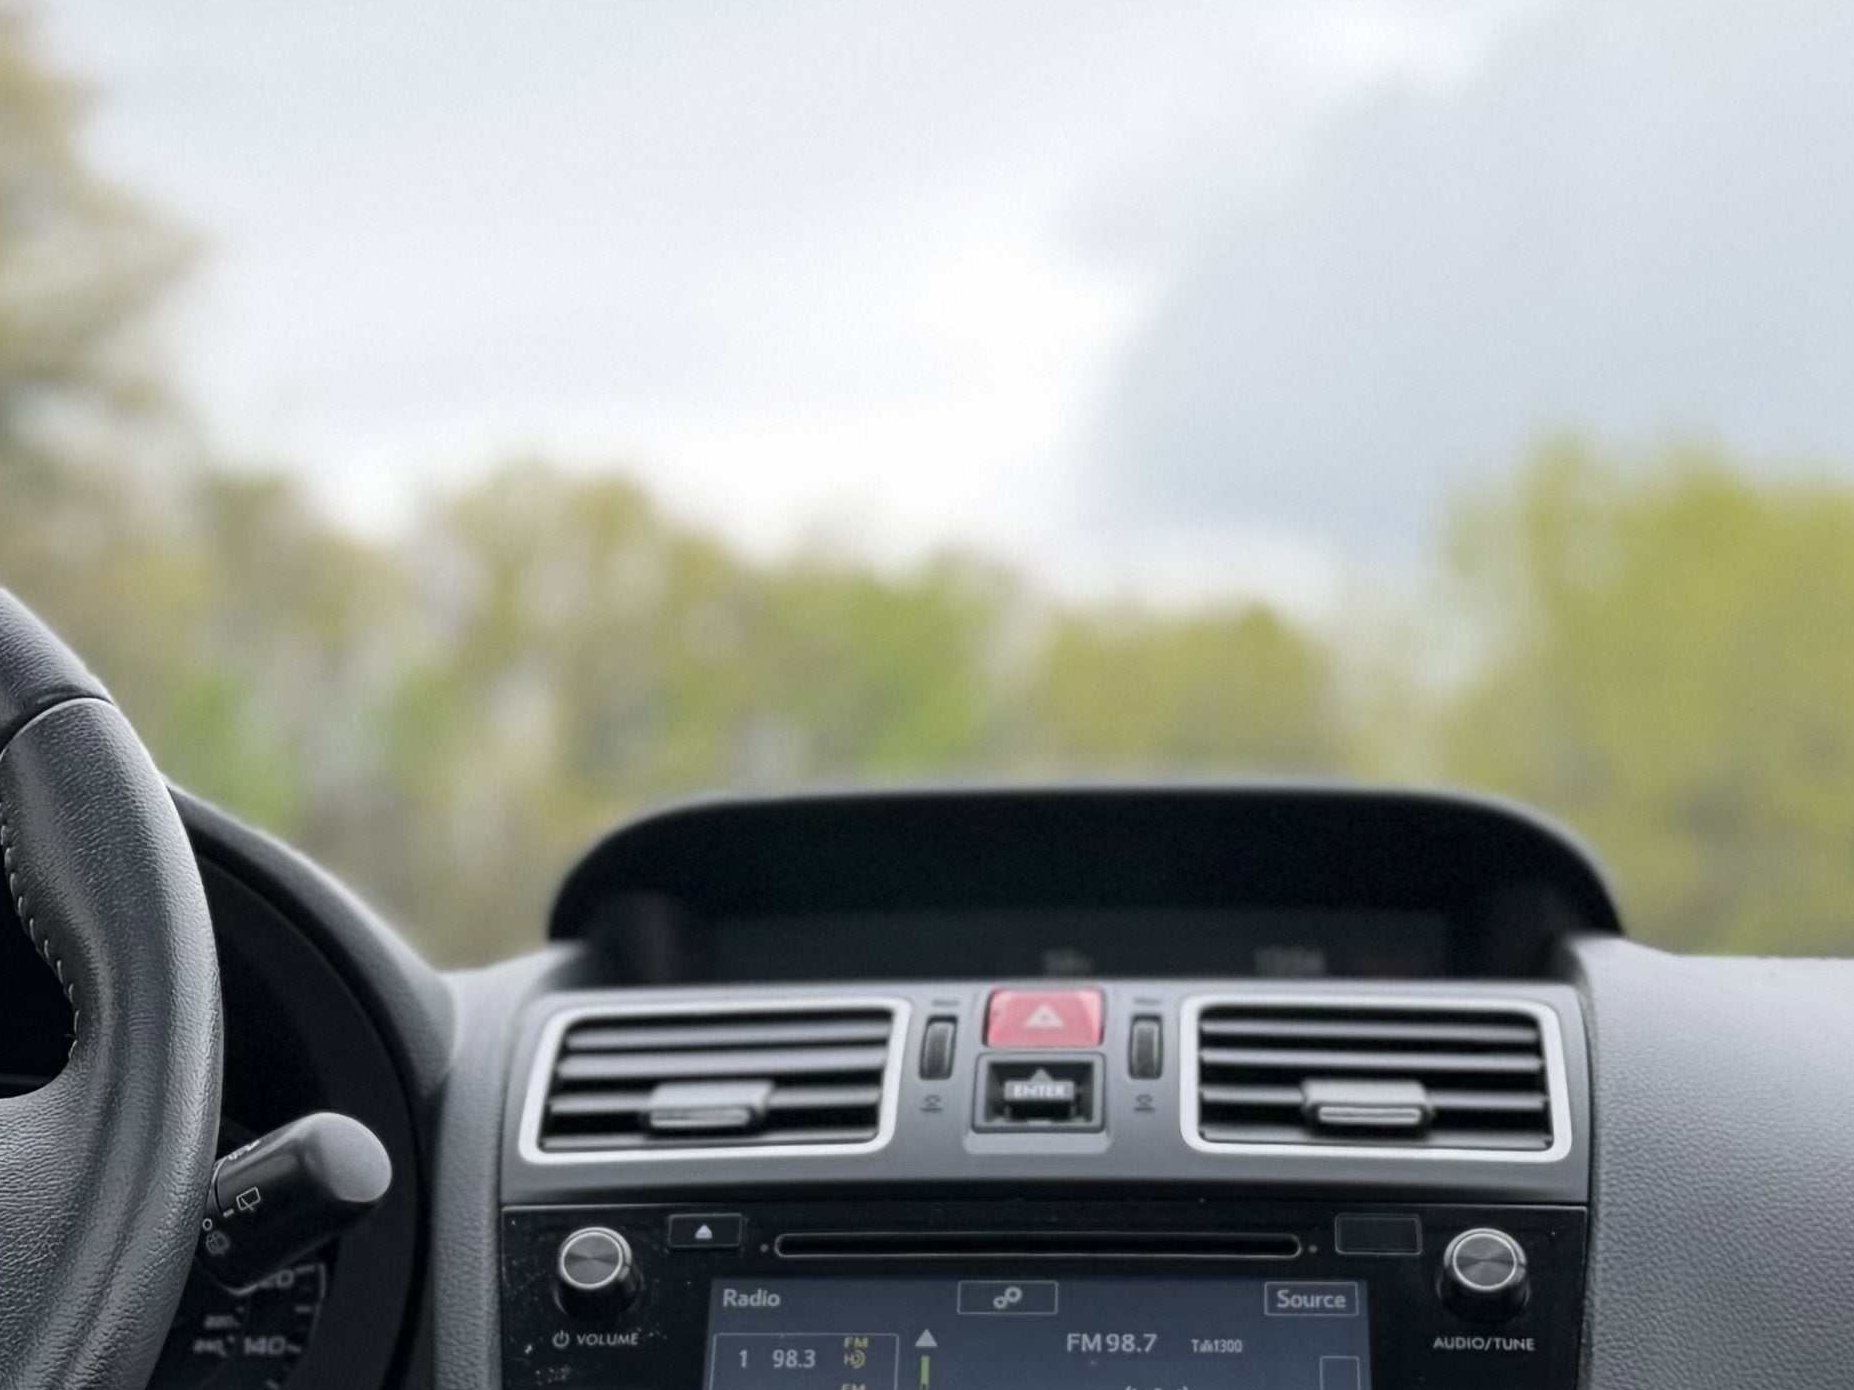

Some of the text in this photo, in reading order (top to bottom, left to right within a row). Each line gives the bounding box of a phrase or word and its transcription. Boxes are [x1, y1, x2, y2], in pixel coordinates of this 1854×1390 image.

[1013, 1083, 1067, 1098] ENTER
[722, 1288, 781, 1308] Radio
[1276, 1289, 1346, 1310] Source
[577, 1333, 639, 1346] VOLUME
[1433, 1337, 1536, 1352] AUDIO/TUNE
[739, 1337, 868, 1370] 1 98.3 FM
